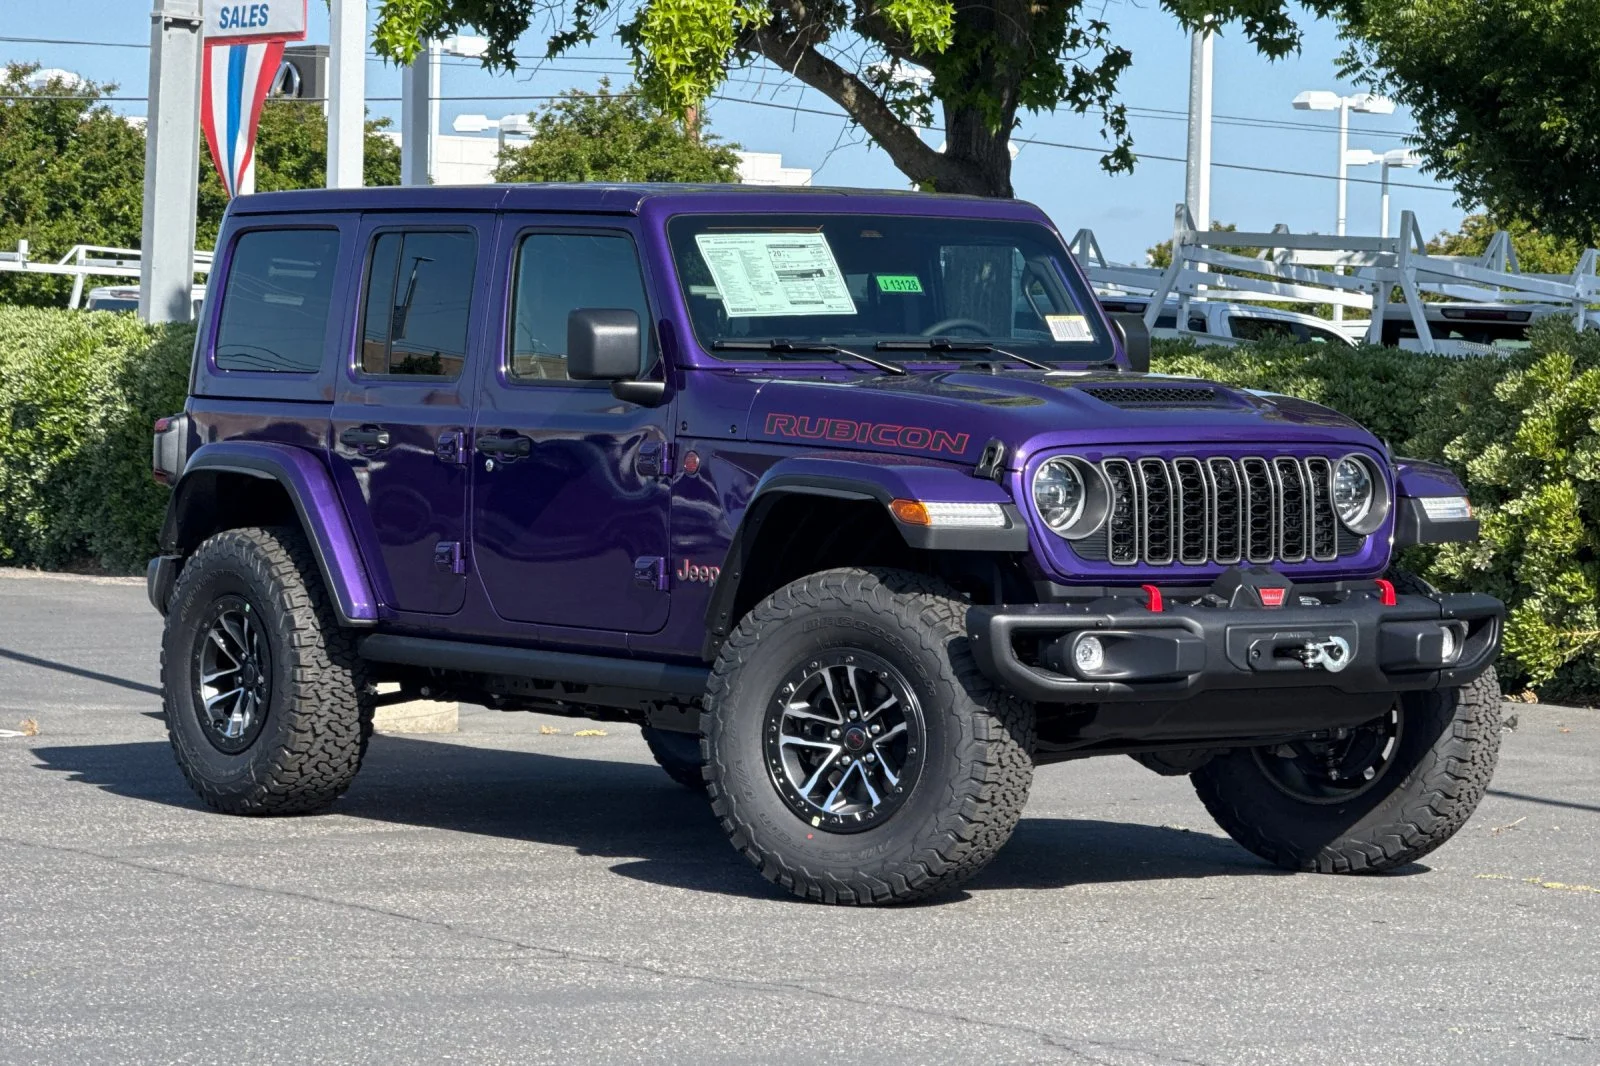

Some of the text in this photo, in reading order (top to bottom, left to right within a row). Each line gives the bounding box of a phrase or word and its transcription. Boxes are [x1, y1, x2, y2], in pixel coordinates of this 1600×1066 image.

[219, 3, 269, 29] SALES
[764, 413, 970, 454] RUBICON
[676, 558, 720, 587] Jeep
